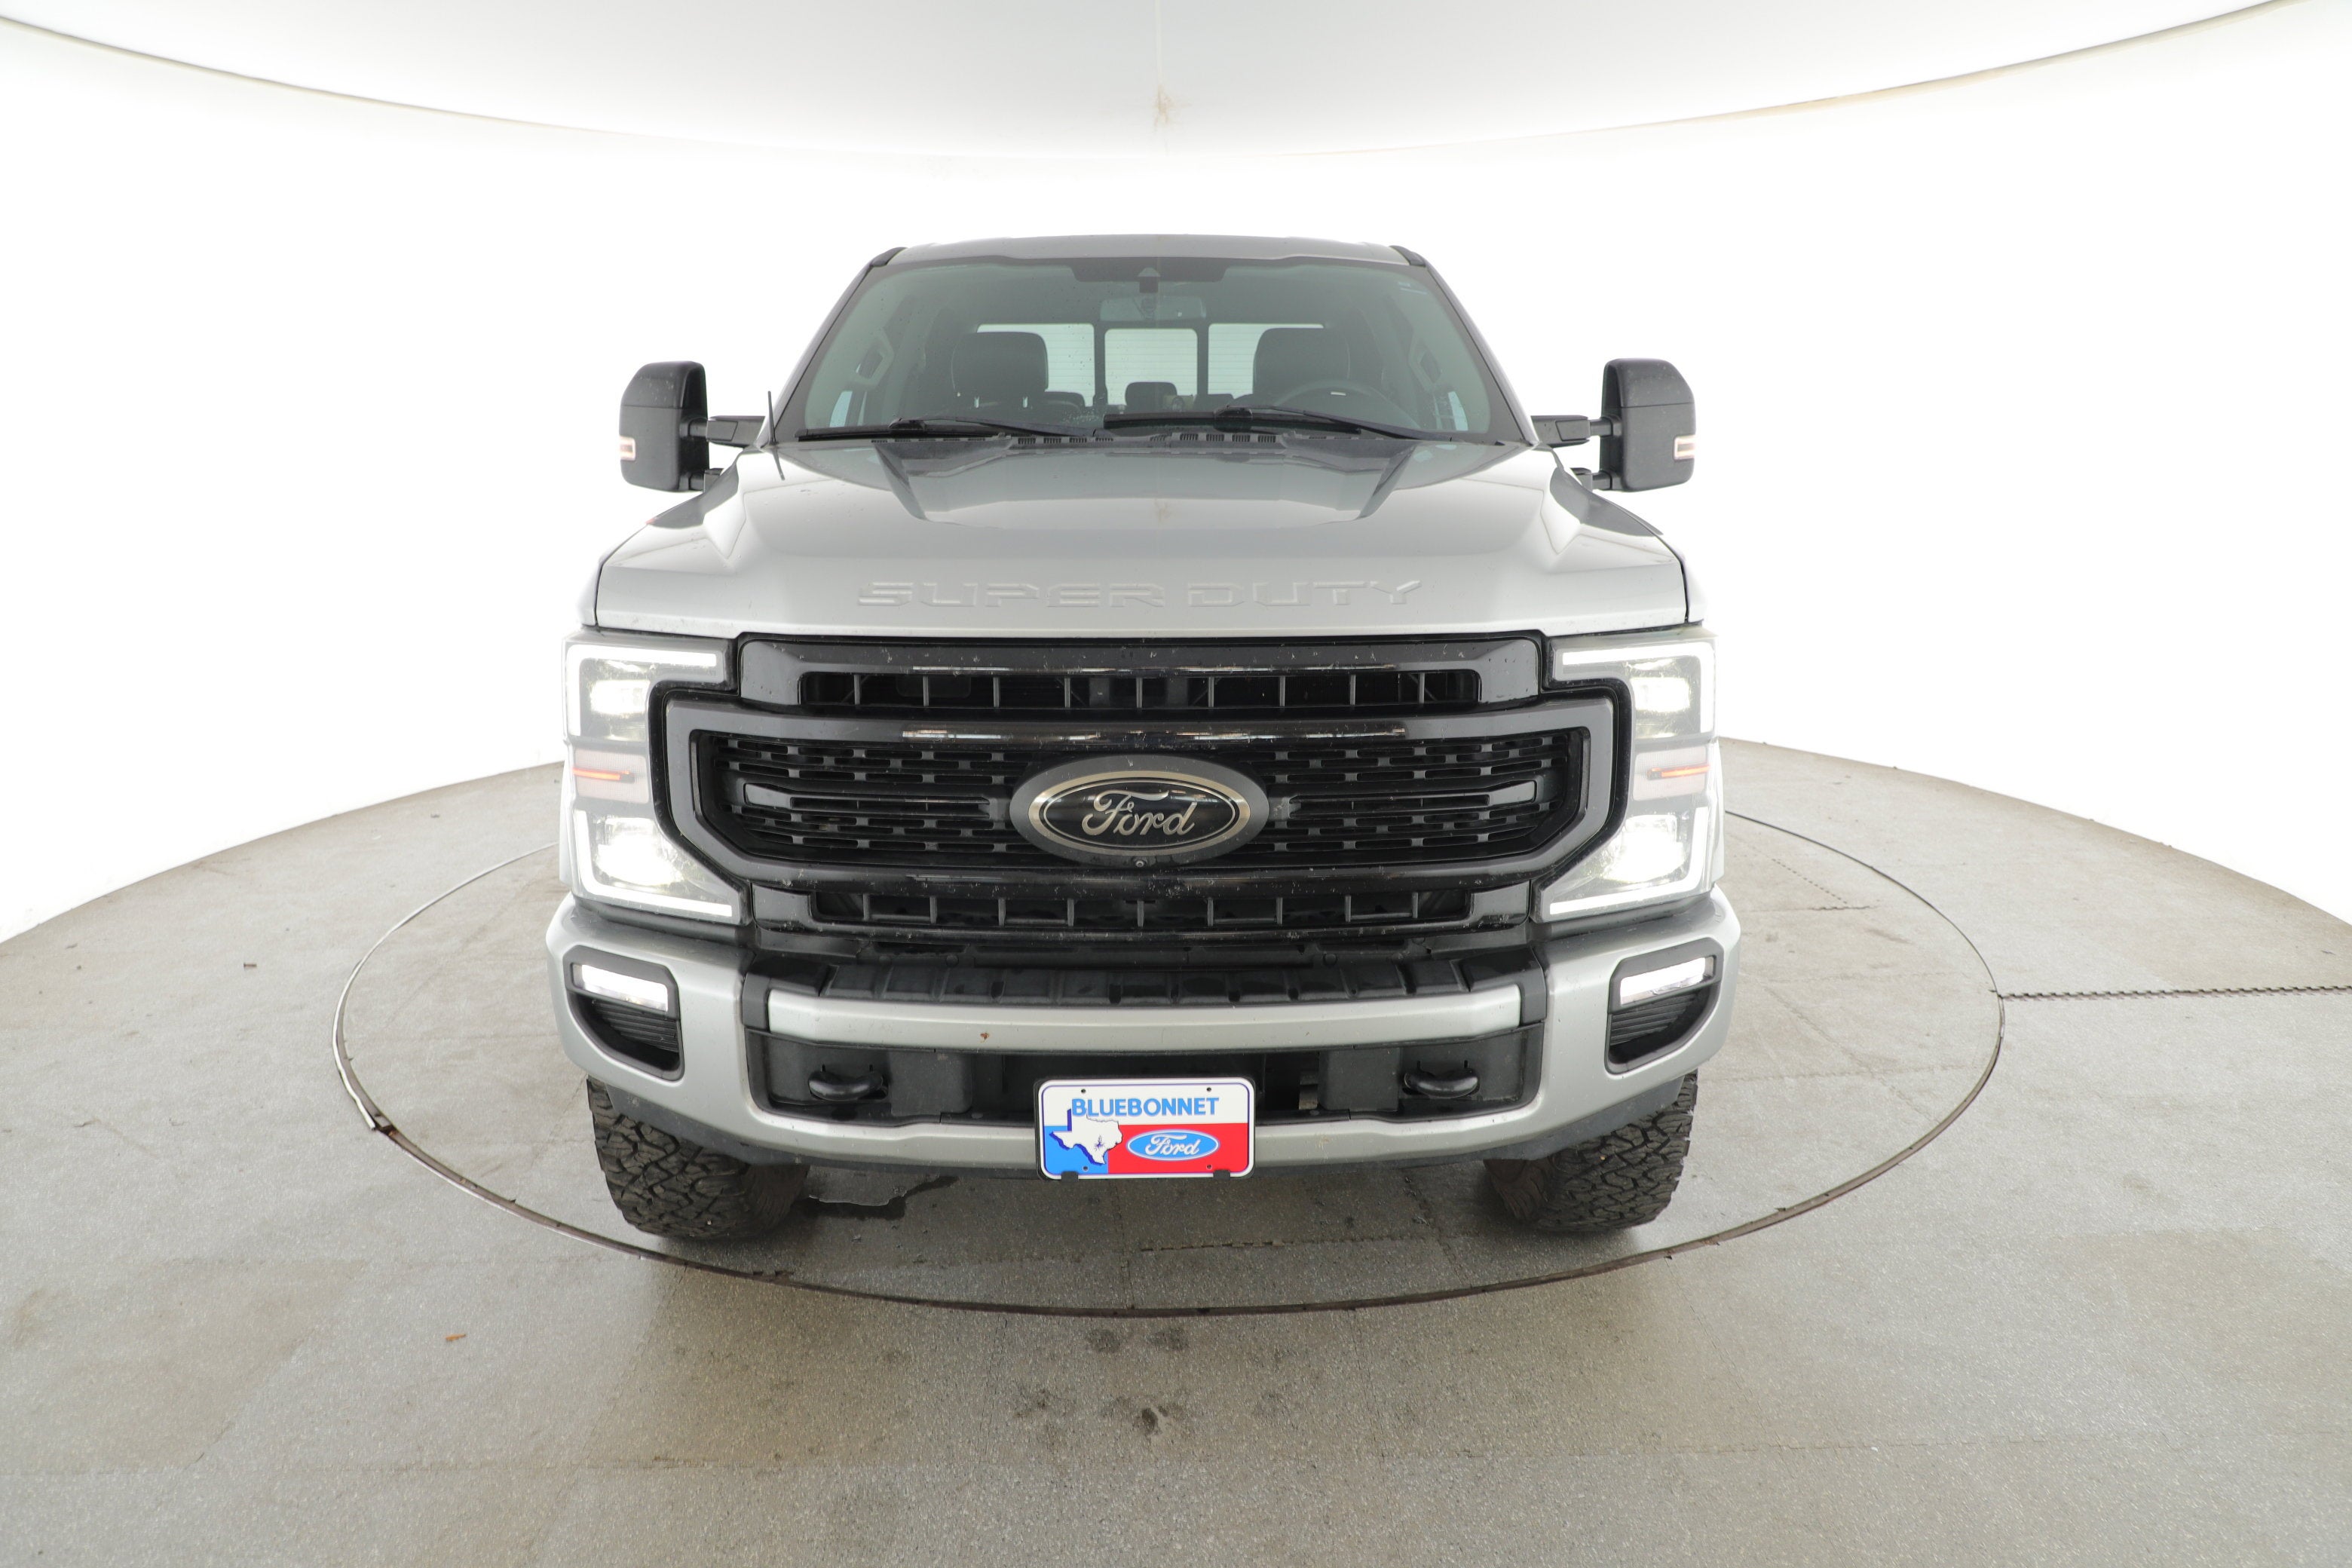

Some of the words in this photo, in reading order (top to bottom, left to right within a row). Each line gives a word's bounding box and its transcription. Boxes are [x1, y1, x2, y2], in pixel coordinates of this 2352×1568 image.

[858, 580, 1165, 608] SUPER
[1187, 580, 1422, 606] DUTY
[1082, 789, 1197, 836] Ford
[1071, 1098, 1220, 1117] BLUEBONNET
[1144, 1133, 1202, 1156] Ford
